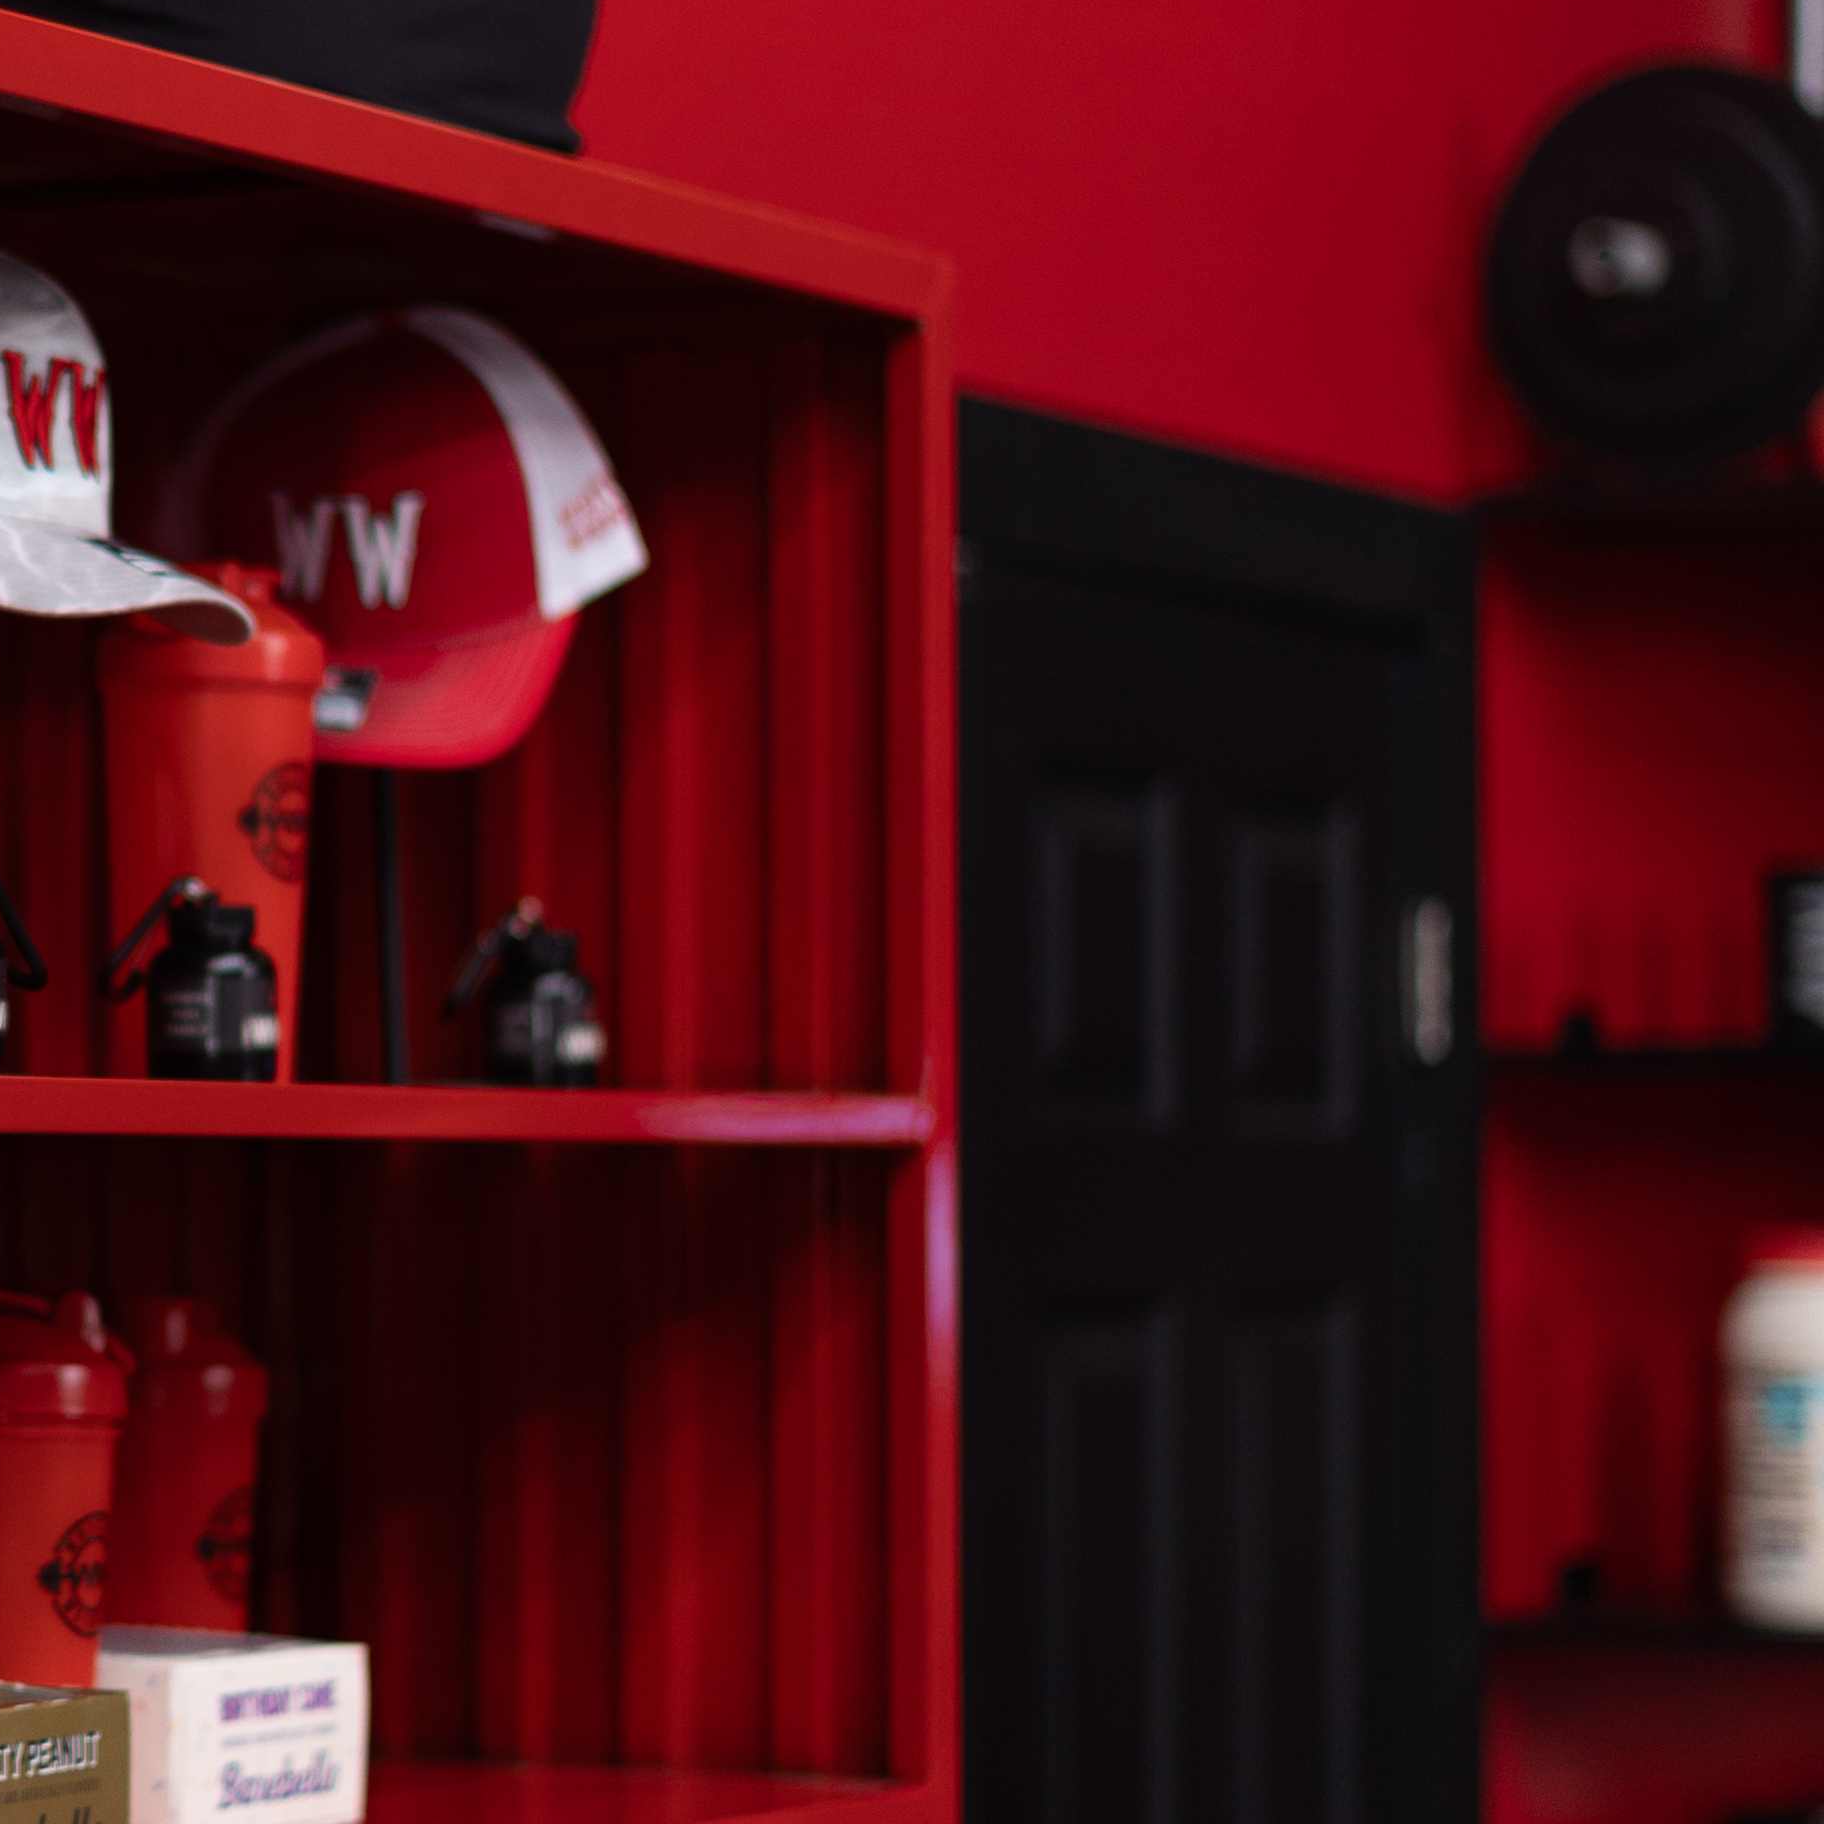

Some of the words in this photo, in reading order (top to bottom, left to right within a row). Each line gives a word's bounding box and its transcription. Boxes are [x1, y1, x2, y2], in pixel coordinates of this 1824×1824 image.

[0, 349, 107, 482] WW
[272, 488, 424, 611] WW
[26, 1729, 103, 1778] PEANUT
